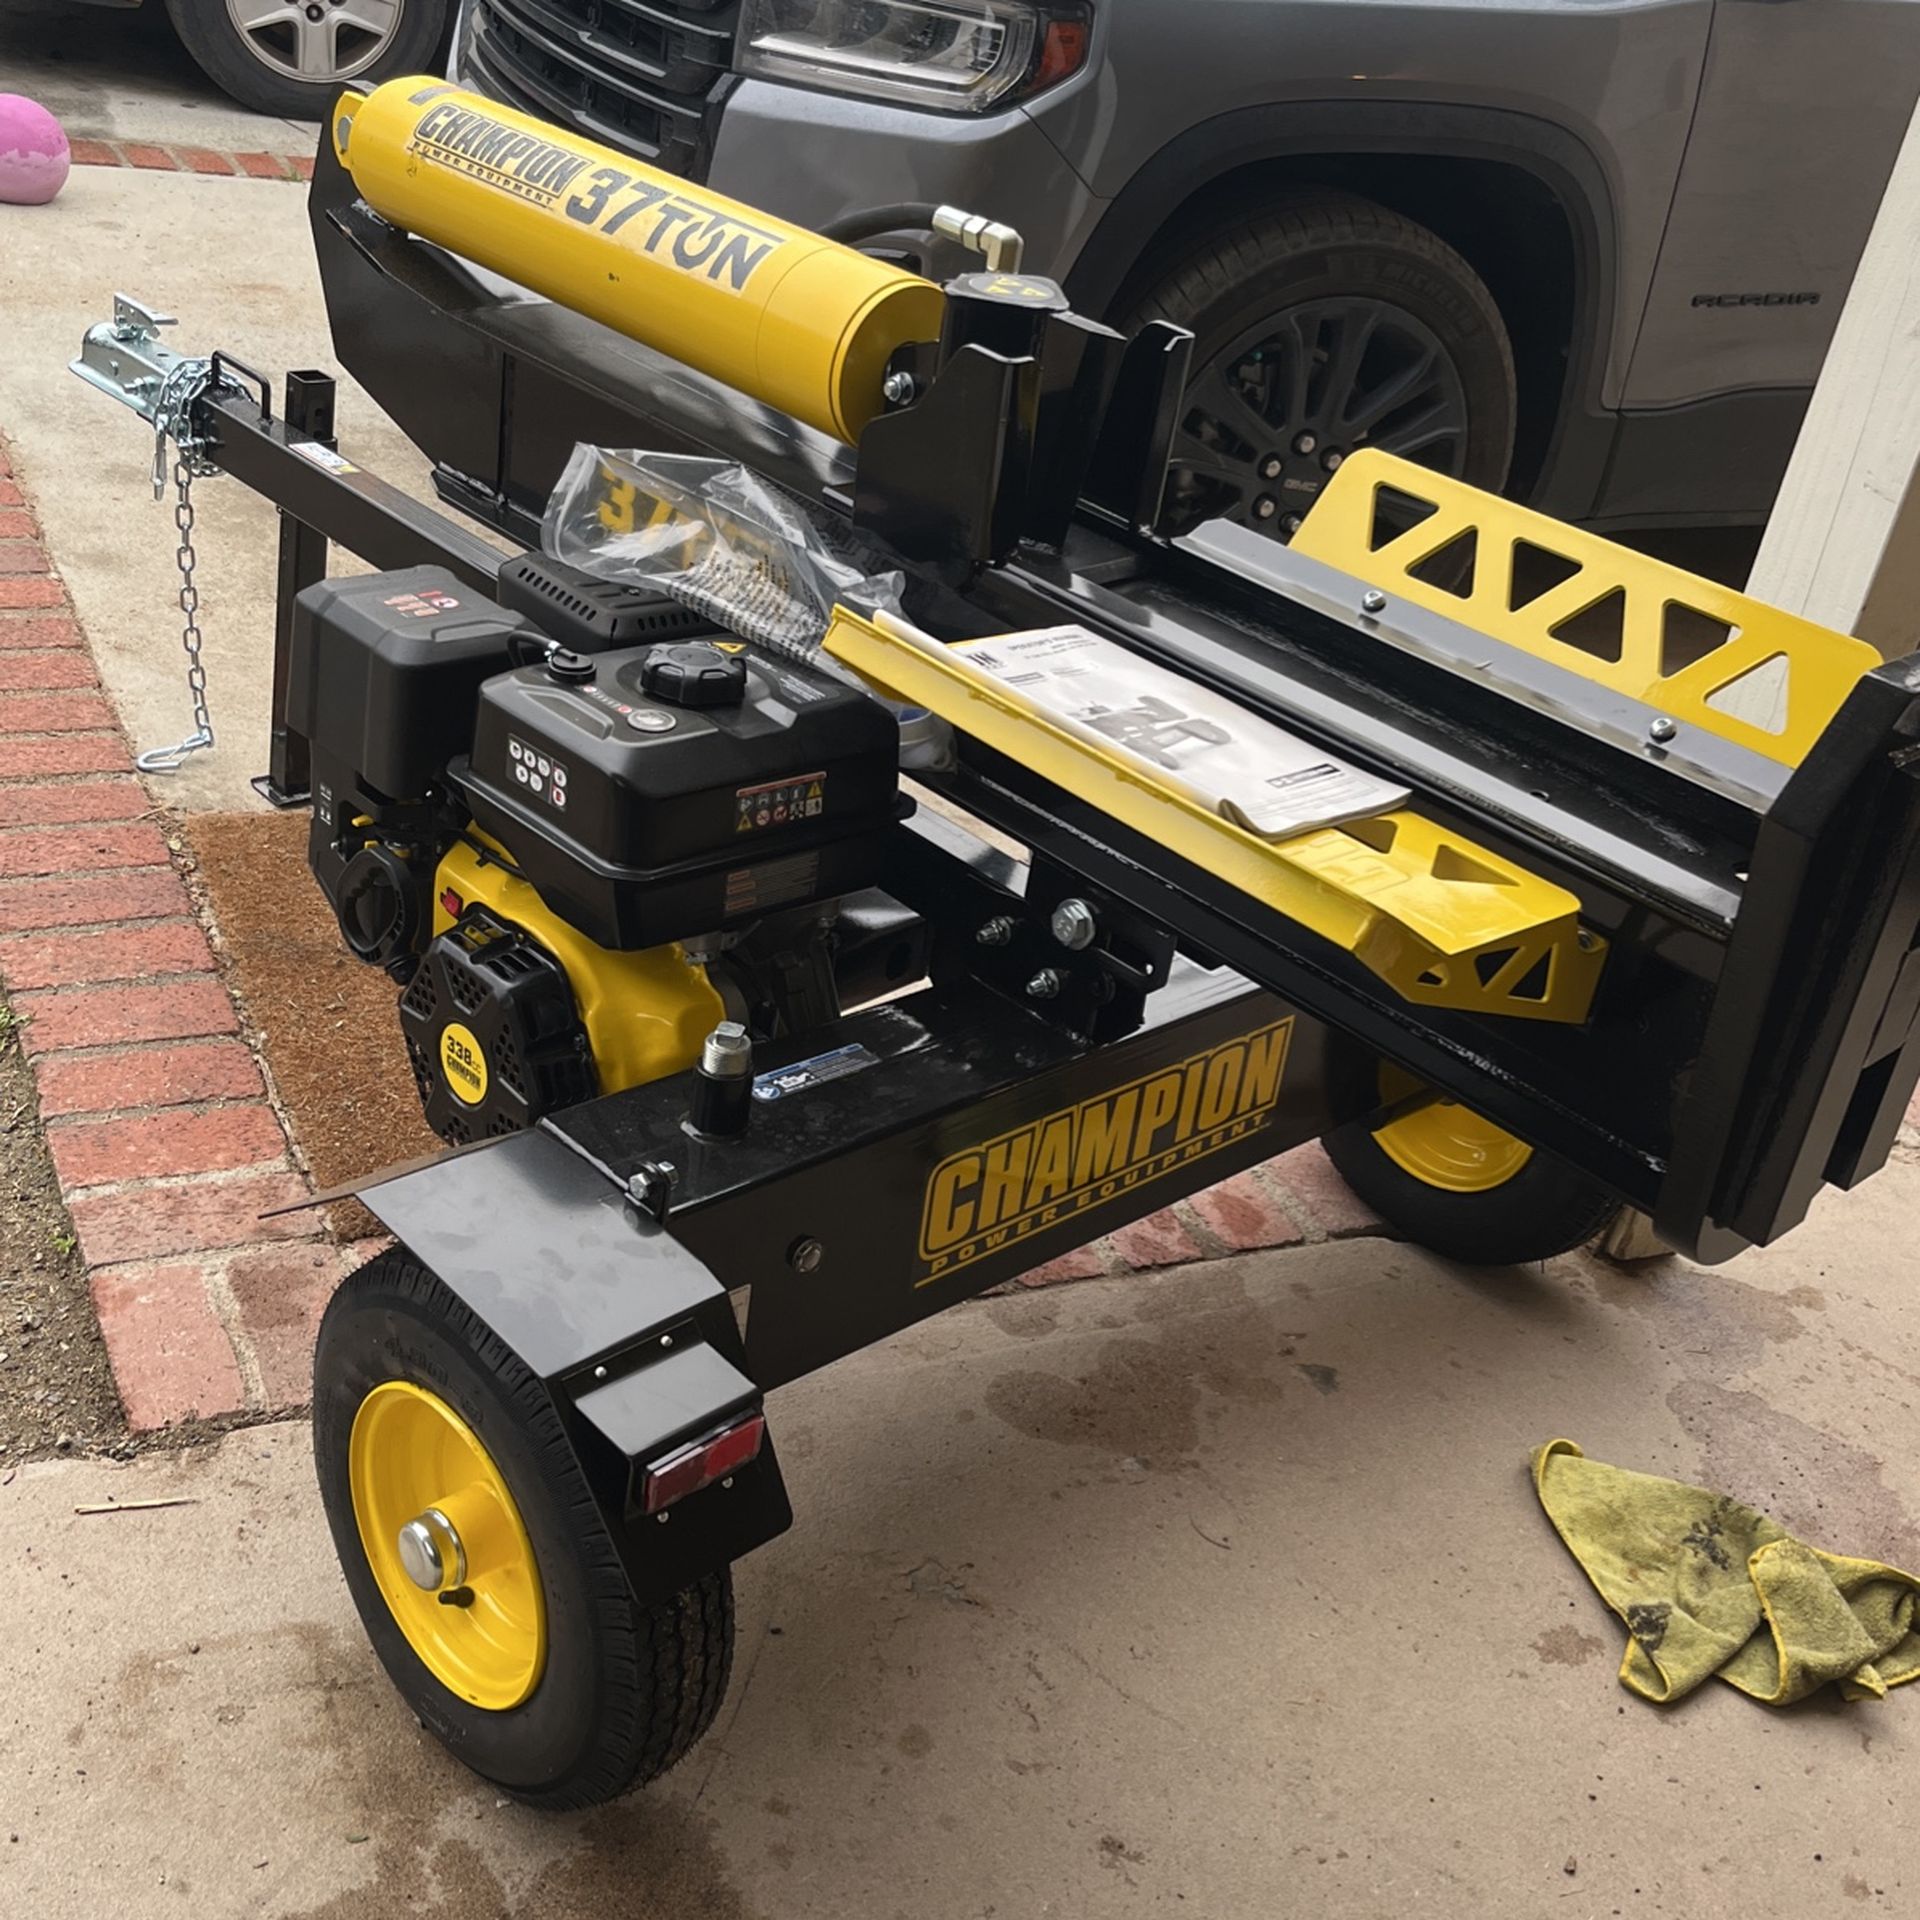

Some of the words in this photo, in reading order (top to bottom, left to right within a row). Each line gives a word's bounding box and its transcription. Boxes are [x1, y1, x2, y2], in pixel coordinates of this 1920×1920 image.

[412, 141, 462, 168] POWER
[467, 163, 554, 206] EQUIPMENT
[419, 105, 588, 195] CHAMPION
[565, 168, 673, 237] 37
[644, 202, 773, 291] TON
[1691, 292, 1821, 308] ACADIA
[925, 1026, 1287, 1249] CHAMPION
[930, 1209, 1057, 1275] POWER
[1077, 1113, 1266, 1208] EQUIPMENT
